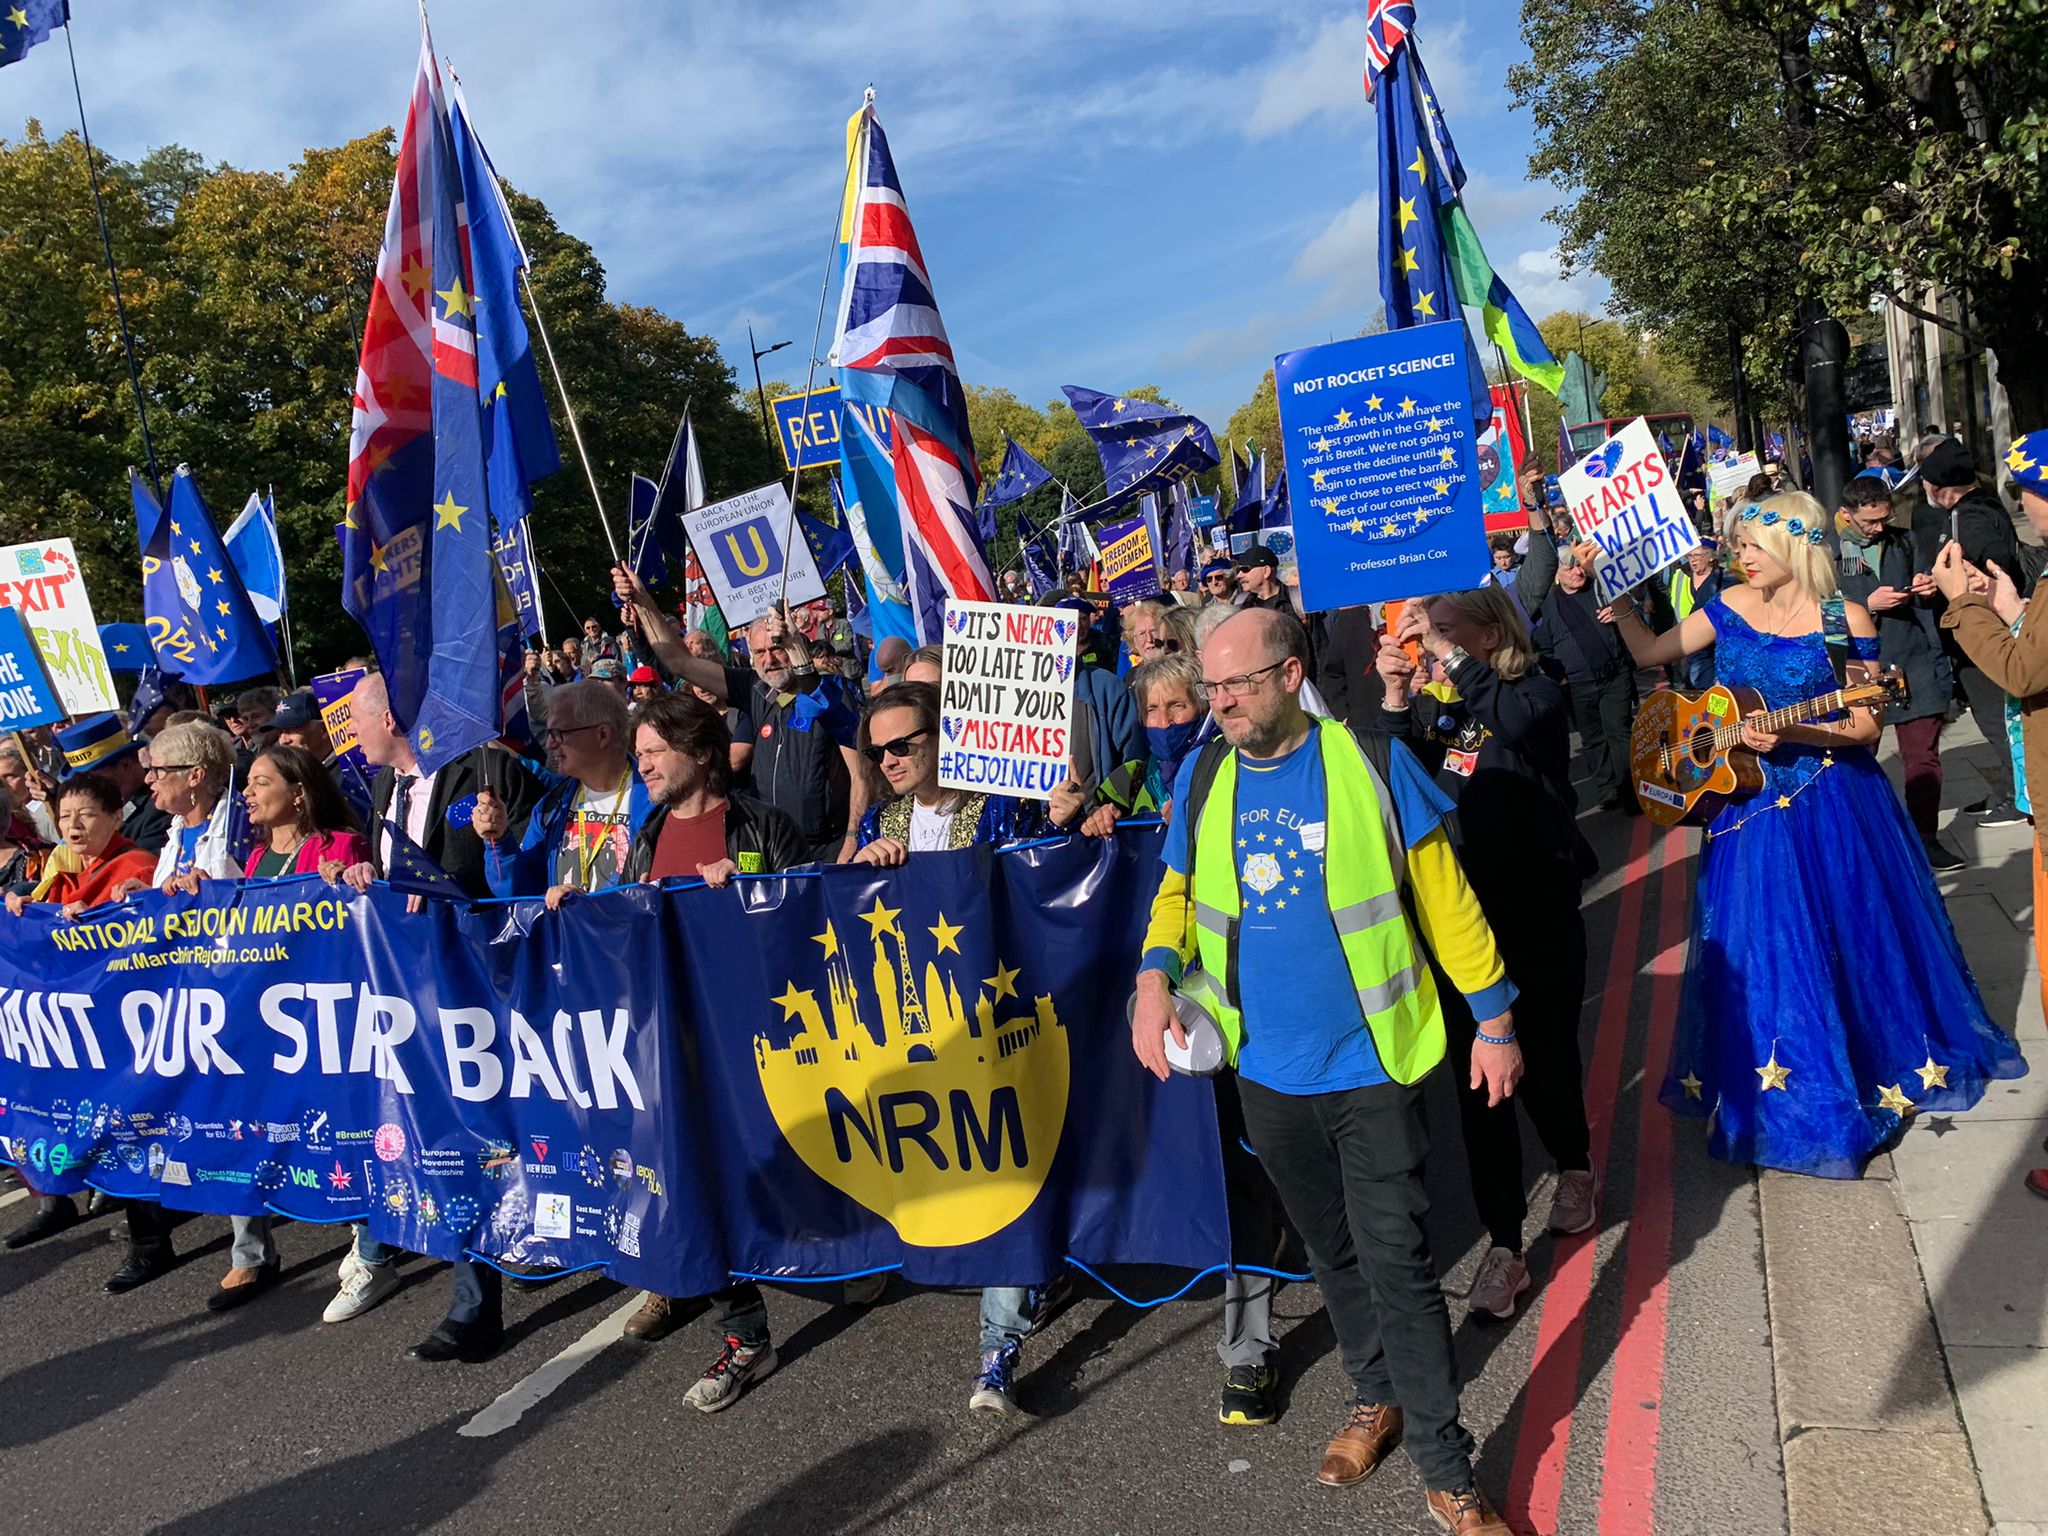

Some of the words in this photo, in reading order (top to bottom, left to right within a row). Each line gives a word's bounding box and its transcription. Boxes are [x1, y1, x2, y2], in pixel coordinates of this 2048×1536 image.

[1293, 377, 1325, 395] NOT
[1327, 365, 1385, 389] ROCKET
[1388, 352, 1456, 378] SCIENCE!
[1323, 419, 1358, 432] reason
[1359, 414, 1377, 427] the
[1378, 410, 1394, 423] UK
[1416, 404, 1442, 416] have
[1443, 400, 1462, 412] the
[1343, 429, 1380, 447] growth
[1382, 426, 1393, 437] in
[1394, 422, 1412, 435] the
[1413, 419, 1428, 431] G7
[1302, 454, 1324, 467] year
[1325, 451, 1334, 461] is
[1335, 446, 1367, 460] Brexit.
[1367, 440, 1399, 455] We're
[1399, 438, 1418, 449] not
[1419, 433, 1451, 448] going
[1452, 430, 1465, 440] to
[1353, 460, 1371, 471] the
[1373, 453, 1411, 468] decline
[1412, 447, 1437, 462] until
[1310, 495, 1332, 508] that
[1332, 493, 1348, 505] we
[1349, 486, 1380, 502] chose
[1382, 484, 1393, 496] to
[1394, 480, 1422, 493] erect
[1423, 475, 1447, 489] with
[1448, 472, 1467, 485] the
[1314, 479, 1344, 493] begin
[1345, 474, 1357, 487] to
[1358, 467, 1398, 484] remove
[1399, 463, 1417, 477] the
[1419, 459, 1459, 475] barriers
[700, 504, 726, 519] BACK
[728, 498, 741, 509] TO
[742, 492, 759, 505] THE
[1336, 504, 1356, 518] rest
[1357, 501, 1369, 515] of
[1369, 500, 1388, 512] our
[1389, 491, 1443, 510] continent.
[1572, 452, 1664, 534] HEARTS
[695, 512, 743, 533] EUROPEAN
[744, 498, 775, 515] UNION
[1360, 517, 1378, 528] not
[1379, 512, 1411, 525] rocket
[1592, 493, 1670, 559] WILL
[1104, 534, 1140, 565] FREEDOM
[1140, 533, 1147, 543] OF
[1105, 542, 1150, 577] MOVEMENT
[1350, 558, 1397, 572] Professor
[1399, 553, 1426, 566] Brian
[1426, 549, 1448, 561] Cox
[1600, 516, 1694, 599] REJOIN
[727, 592, 745, 604] THE
[747, 583, 768, 597] BEST
[771, 569, 806, 586] U-URN
[752, 595, 763, 605] OF
[768, 588, 783, 600] AL
[965, 610, 1002, 640] IT'S
[1006, 612, 1055, 646] NEVER
[946, 643, 977, 675] TOO
[980, 645, 1026, 681] LATE
[1031, 650, 1055, 683] TO
[943, 680, 1007, 715] ADMIT
[1013, 687, 1067, 721] YOUR
[326, 702, 351, 731] FREED
[960, 718, 1067, 759] MISTAKES
[1649, 787, 1673, 802] EUROPA
[1239, 808, 1270, 826] FOR
[50, 916, 157, 951] NATIONAL
[163, 906, 247, 941] REJOIN
[120, 987, 246, 1078] OUR
[437, 1007, 646, 1112] BACK
[194, 1122, 225, 1130] Scientists
[215, 1131, 226, 1139] EU
[275, 1132, 301, 1144] EUROPE
[824, 1084, 1030, 1173] NRM
[421, 1149, 461, 1158] European
[421, 1159, 465, 1167] Movement
[288, 1165, 321, 1189] Volt
[575, 1205, 588, 1213] East
[588, 1206, 602, 1215] Kent
[576, 1215, 585, 1223] for
[575, 1226, 597, 1237] Europe
